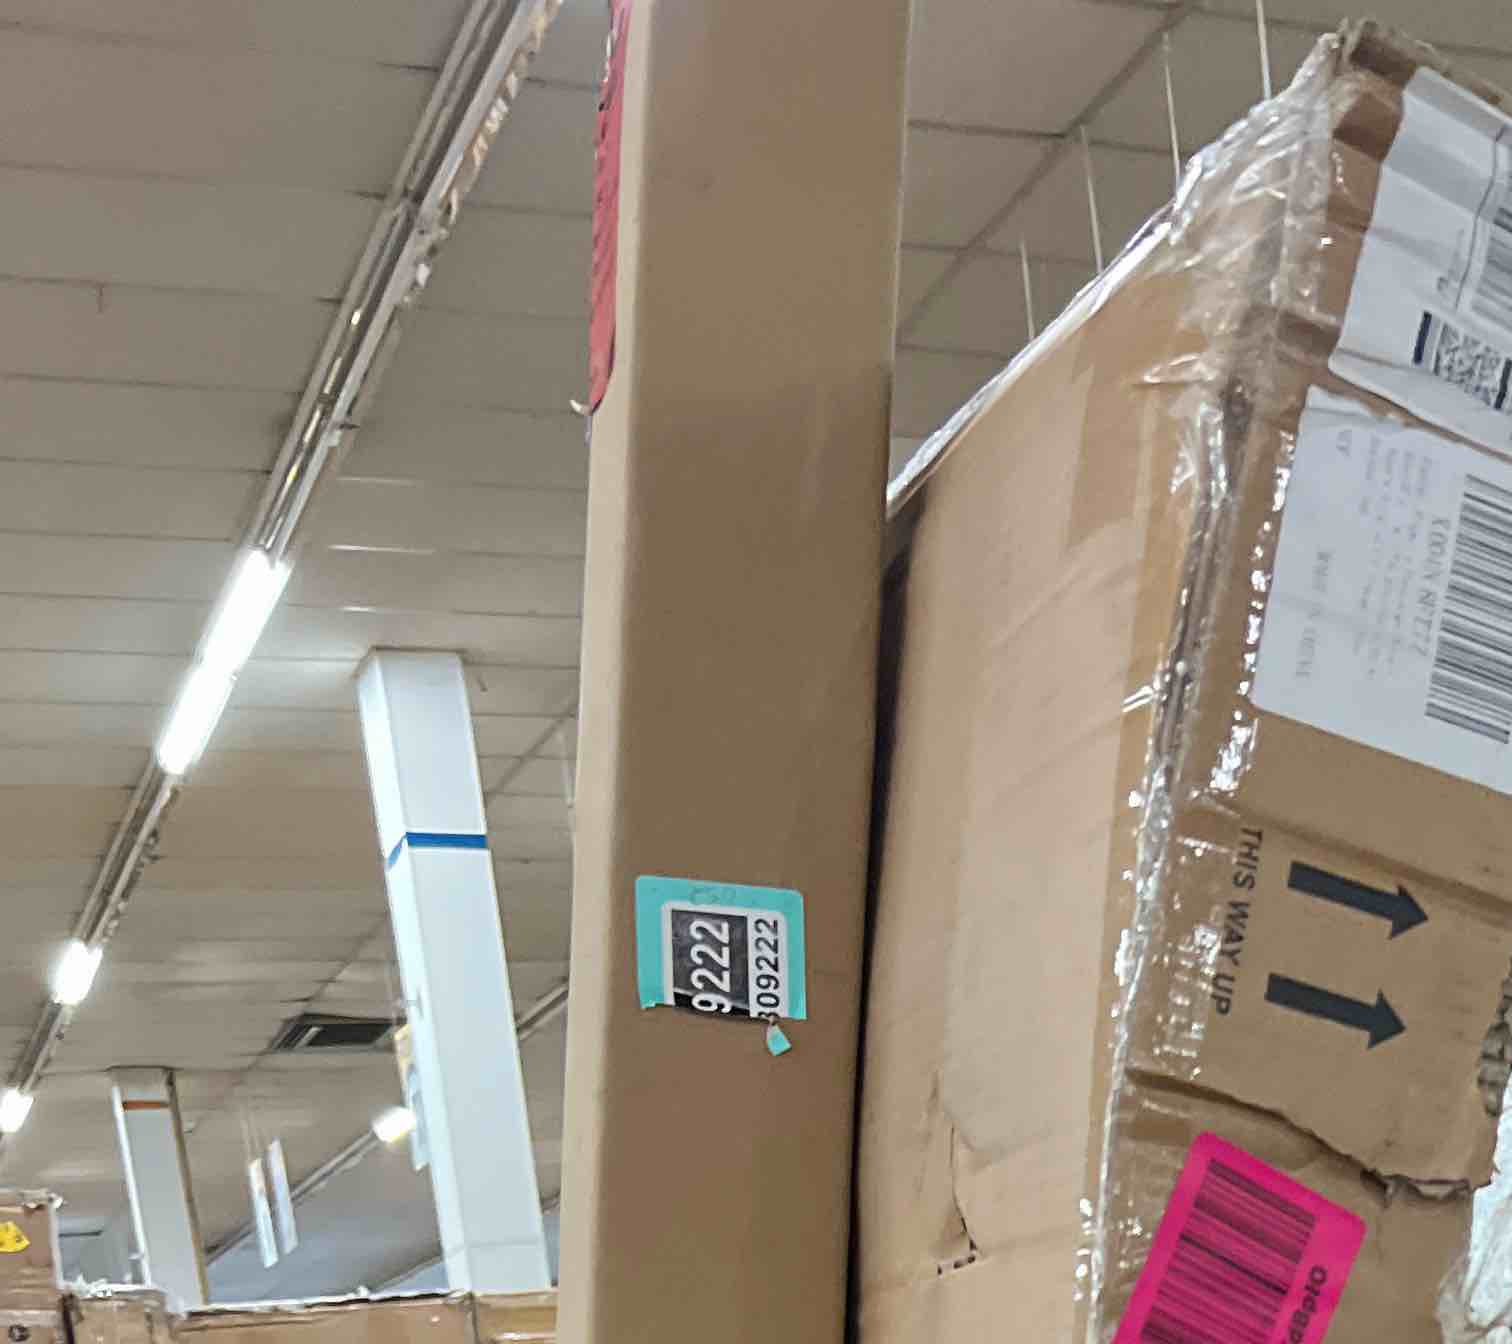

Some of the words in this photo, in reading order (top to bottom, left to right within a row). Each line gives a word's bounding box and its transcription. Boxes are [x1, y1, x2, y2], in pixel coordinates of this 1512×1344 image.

[1232, 827, 1264, 891] THIS
[688, 919, 733, 1014] 9222
[1219, 901, 1250, 967] WAY
[1210, 972, 1236, 1016] UP
